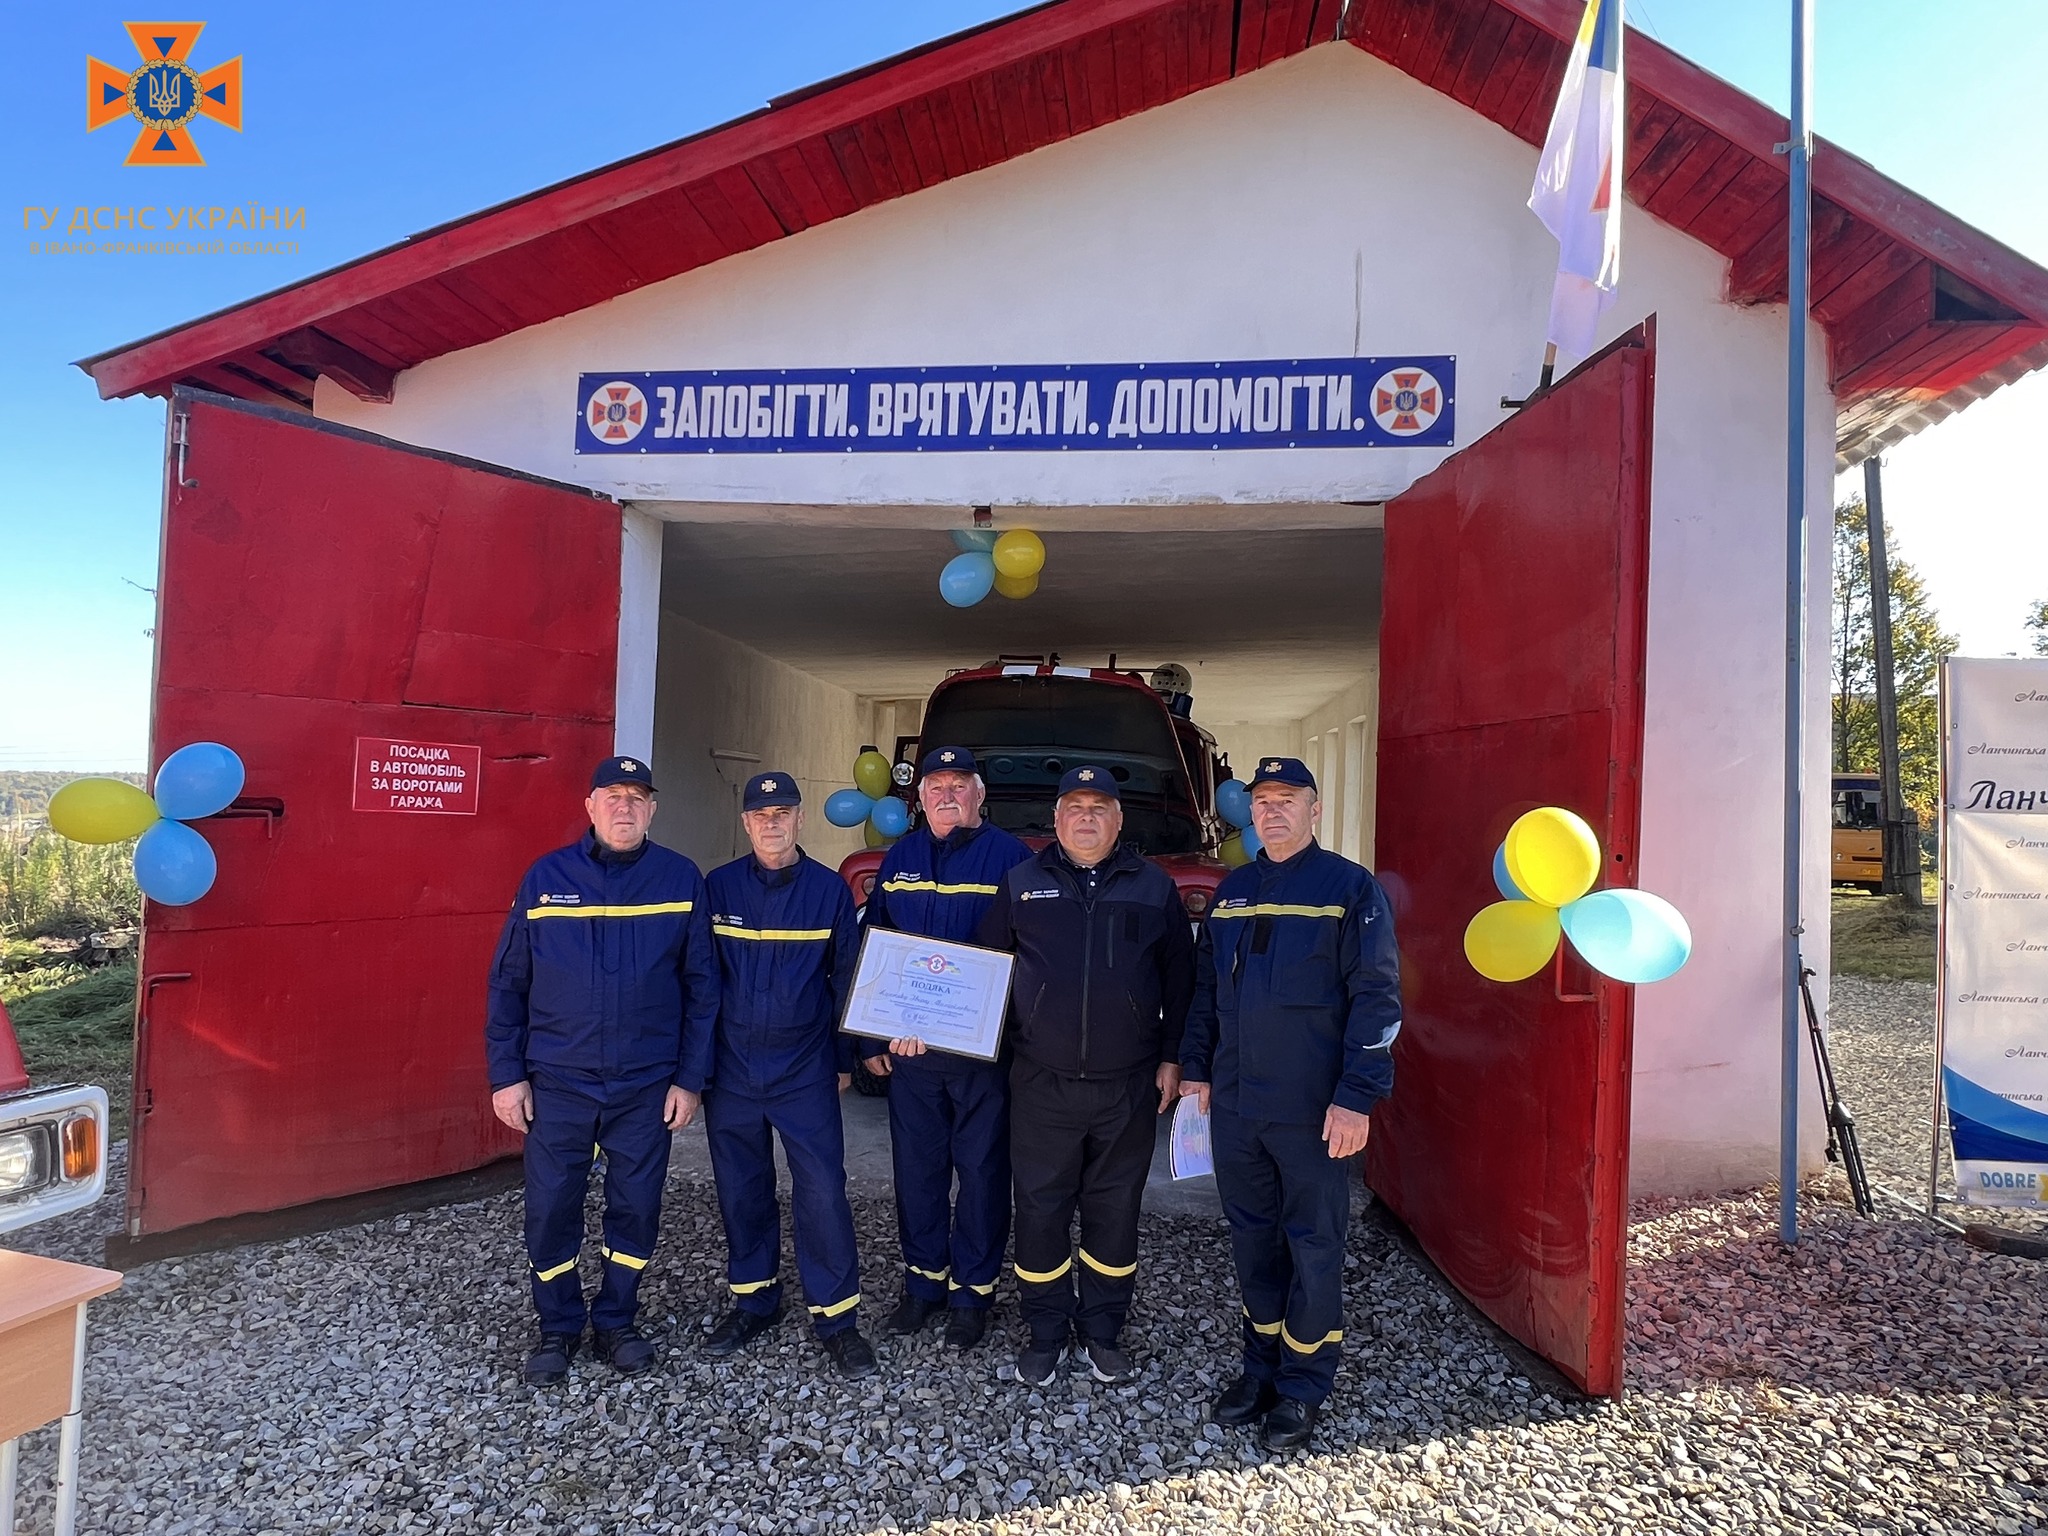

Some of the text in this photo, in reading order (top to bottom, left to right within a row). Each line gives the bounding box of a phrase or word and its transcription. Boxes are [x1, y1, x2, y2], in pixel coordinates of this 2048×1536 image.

[654, 374, 1366, 439] ЗАПОБІГТИ. ВРЯТУВАТИ. ДОПОМОГТИ.
[389, 744, 451, 762] ПОСАДКА
[1967, 742, 2046, 755] Ланчинська
[370, 760, 466, 778] В АВТОМОБІЛЬ
[371, 777, 463, 794] ЗА ВОРОТАМИ
[390, 795, 444, 809] ГАРАЖА
[1962, 886, 2041, 900] Ланчинська
[911, 980, 951, 995] ПОДЯКА
[1958, 990, 2039, 1004] Ланчинська
[1979, 1171, 2036, 1189] DOBRE
